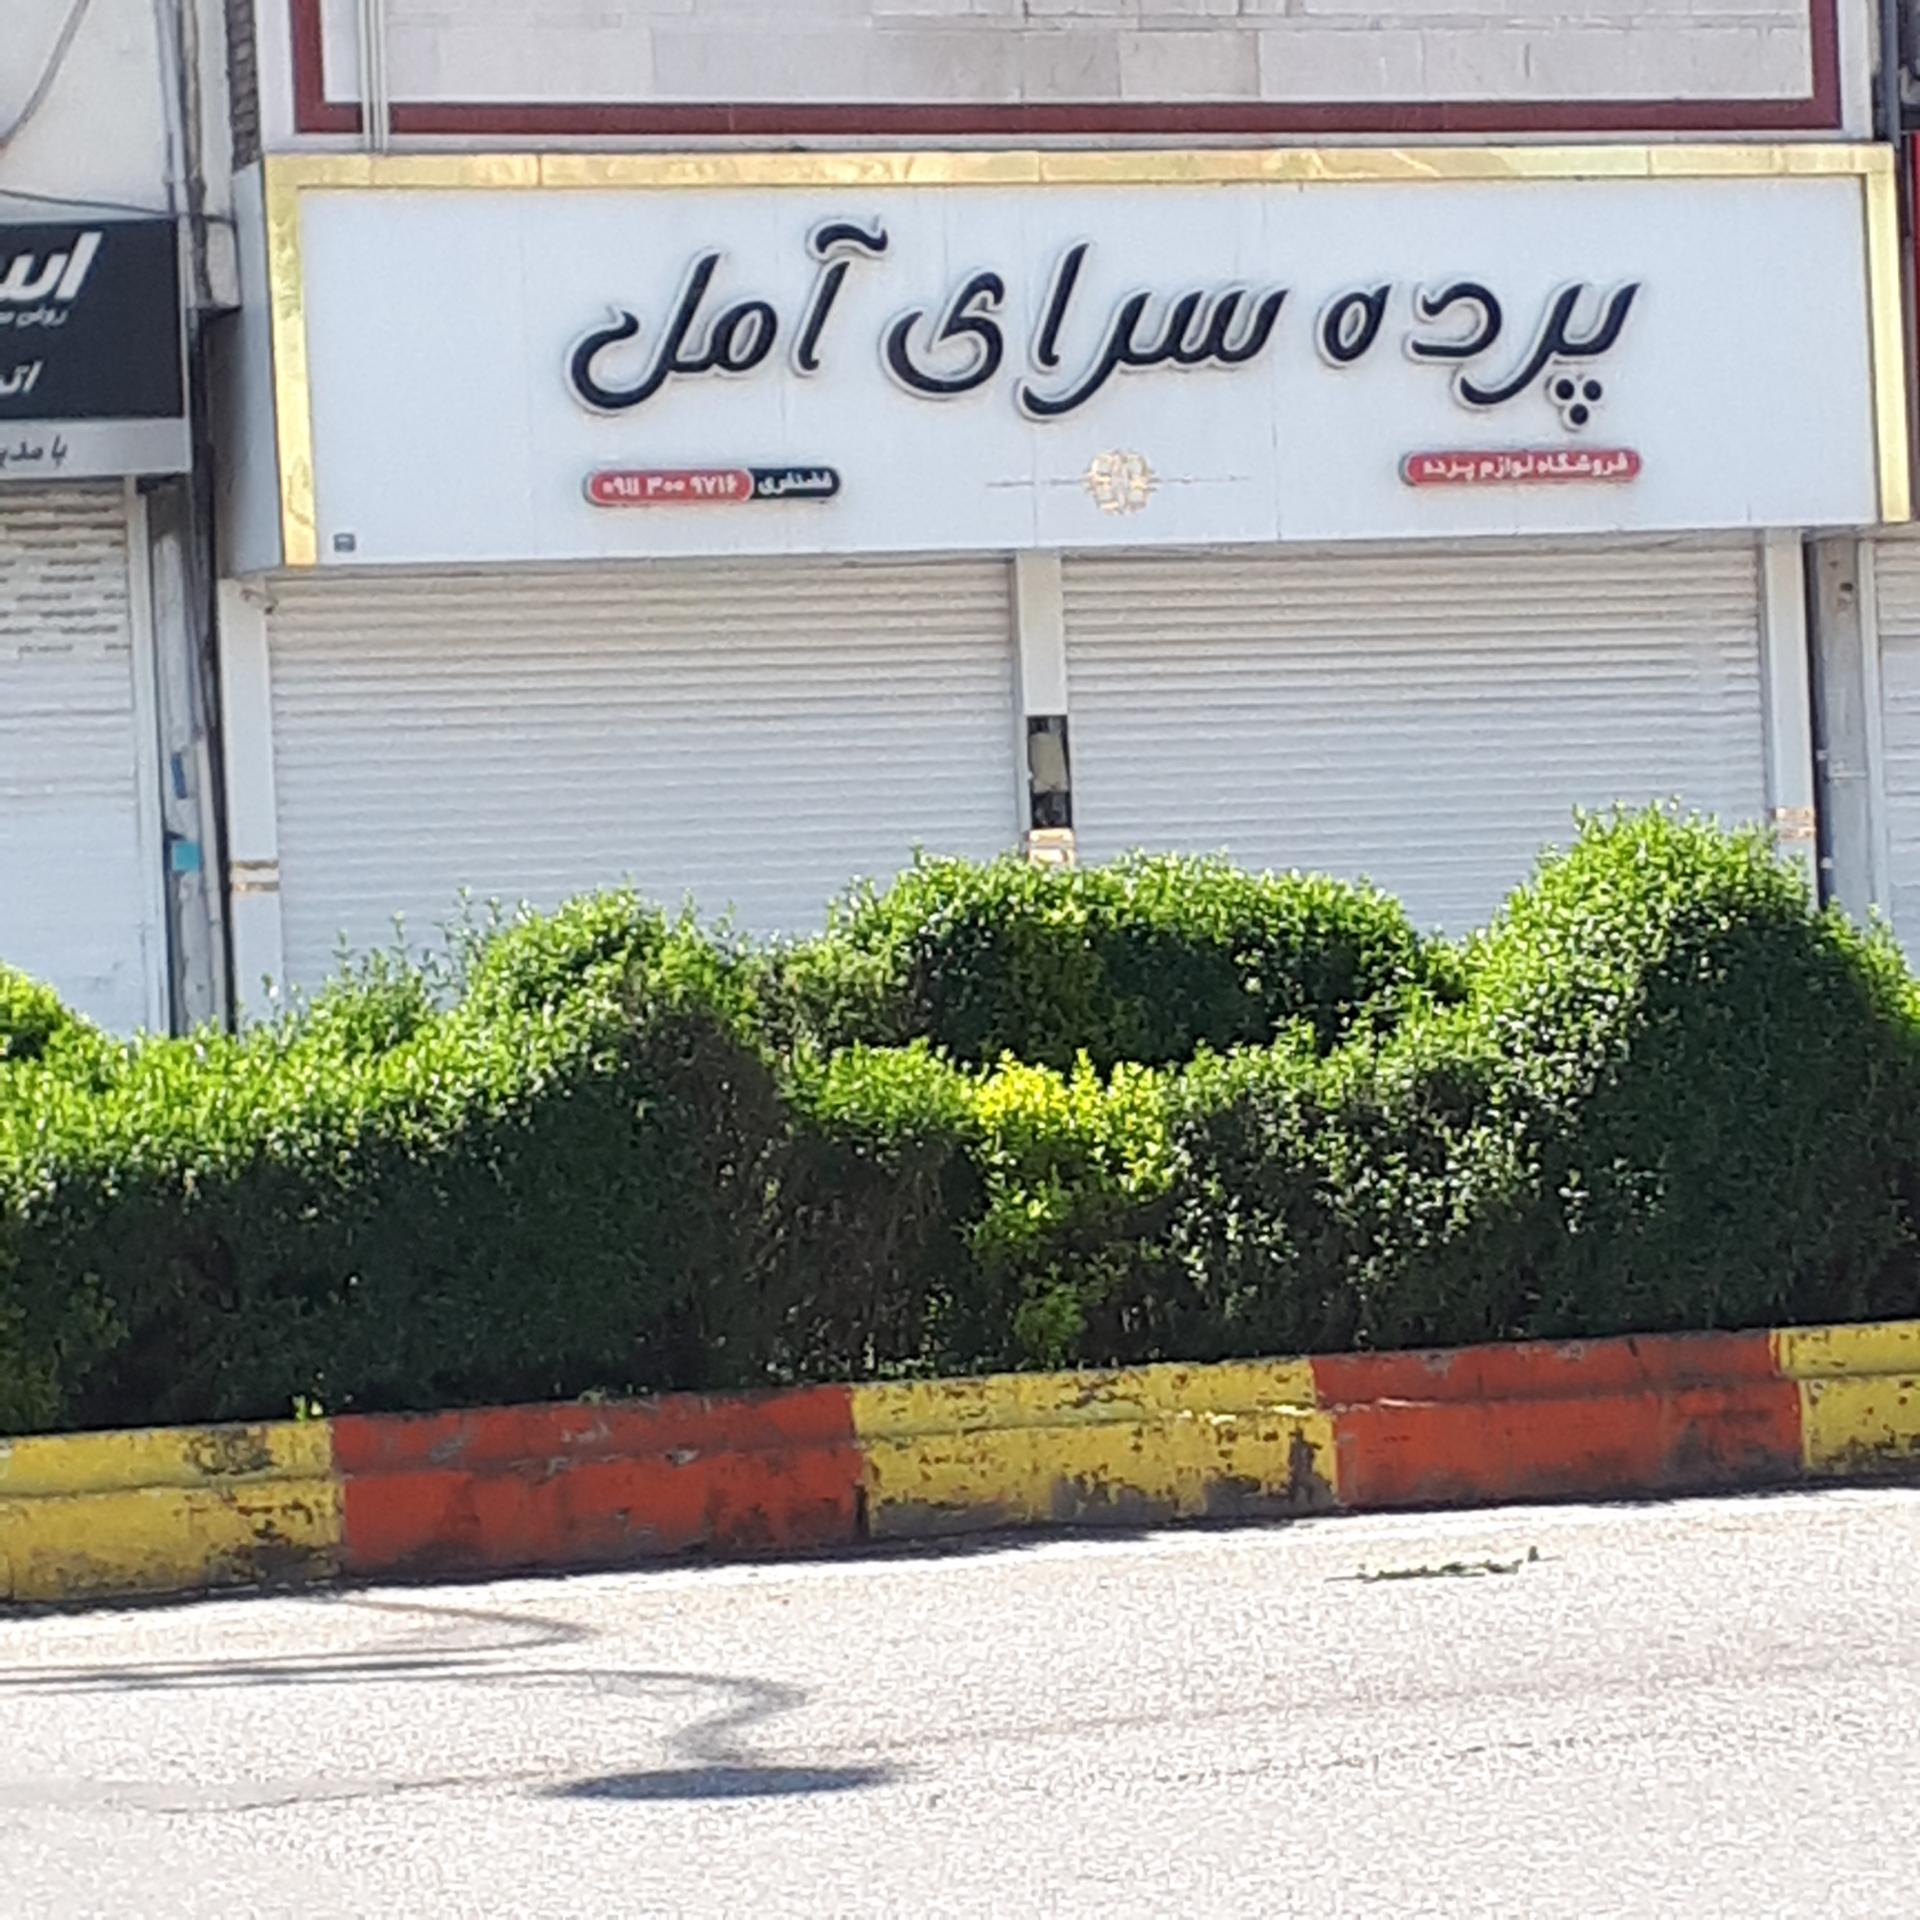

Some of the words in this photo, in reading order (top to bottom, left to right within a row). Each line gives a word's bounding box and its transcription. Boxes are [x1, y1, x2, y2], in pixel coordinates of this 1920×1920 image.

[567, 218, 888, 413] آمل
[880, 242, 1289, 420] سرای
[1319, 280, 1643, 429] پرده
[1423, 458, 1475, 481] پرده
[1479, 454, 1534, 479] لوازم
[1537, 452, 1629, 477] فروشگاه
[601, 476, 639, 496] ۰۹۱۱
[646, 475, 684, 495] ۳۰۰
